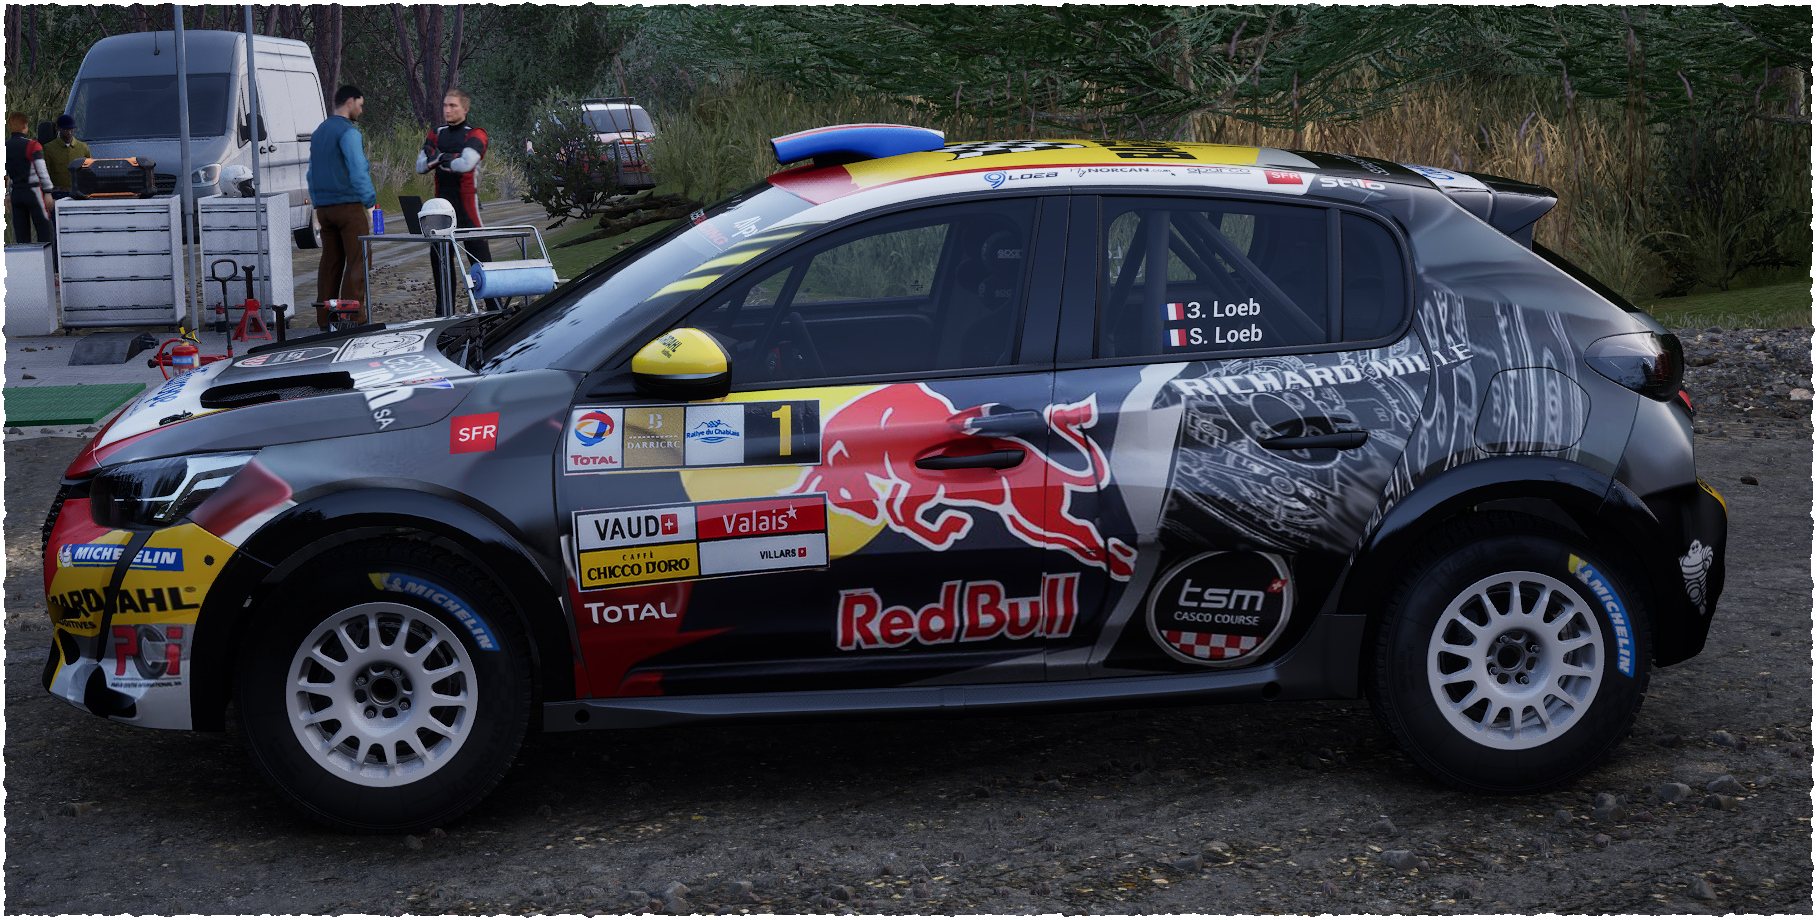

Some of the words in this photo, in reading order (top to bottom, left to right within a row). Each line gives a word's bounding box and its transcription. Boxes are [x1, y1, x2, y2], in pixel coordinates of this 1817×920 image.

[1271, 171, 1301, 180] SFR
[1320, 177, 1386, 191] Stilo
[1213, 298, 1261, 318] Loeb
[1190, 327, 1208, 345] S.
[1215, 324, 1263, 344] Loeb
[1172, 365, 1363, 396] RICHARD
[1371, 343, 1474, 379] MILLE
[458, 424, 496, 442] SFR
[686, 430, 705, 439] Rallye
[714, 428, 740, 437] Chablais
[771, 405, 792, 456] 1
[571, 454, 618, 466] TOTAL
[594, 514, 660, 541] VAUD
[722, 509, 788, 534] Valais
[759, 548, 797, 560] VILLARS
[587, 563, 642, 581] CHICCO
[646, 558, 690, 575] D'ORO
[1178, 579, 1265, 611] tsm
[404, 582, 494, 649] MICHELIN
[584, 602, 678, 625] TOTAL
[1173, 610, 1212, 623] CASCO
[1214, 614, 1260, 626] COURSE
[1591, 579, 1632, 674] MICHELIN
